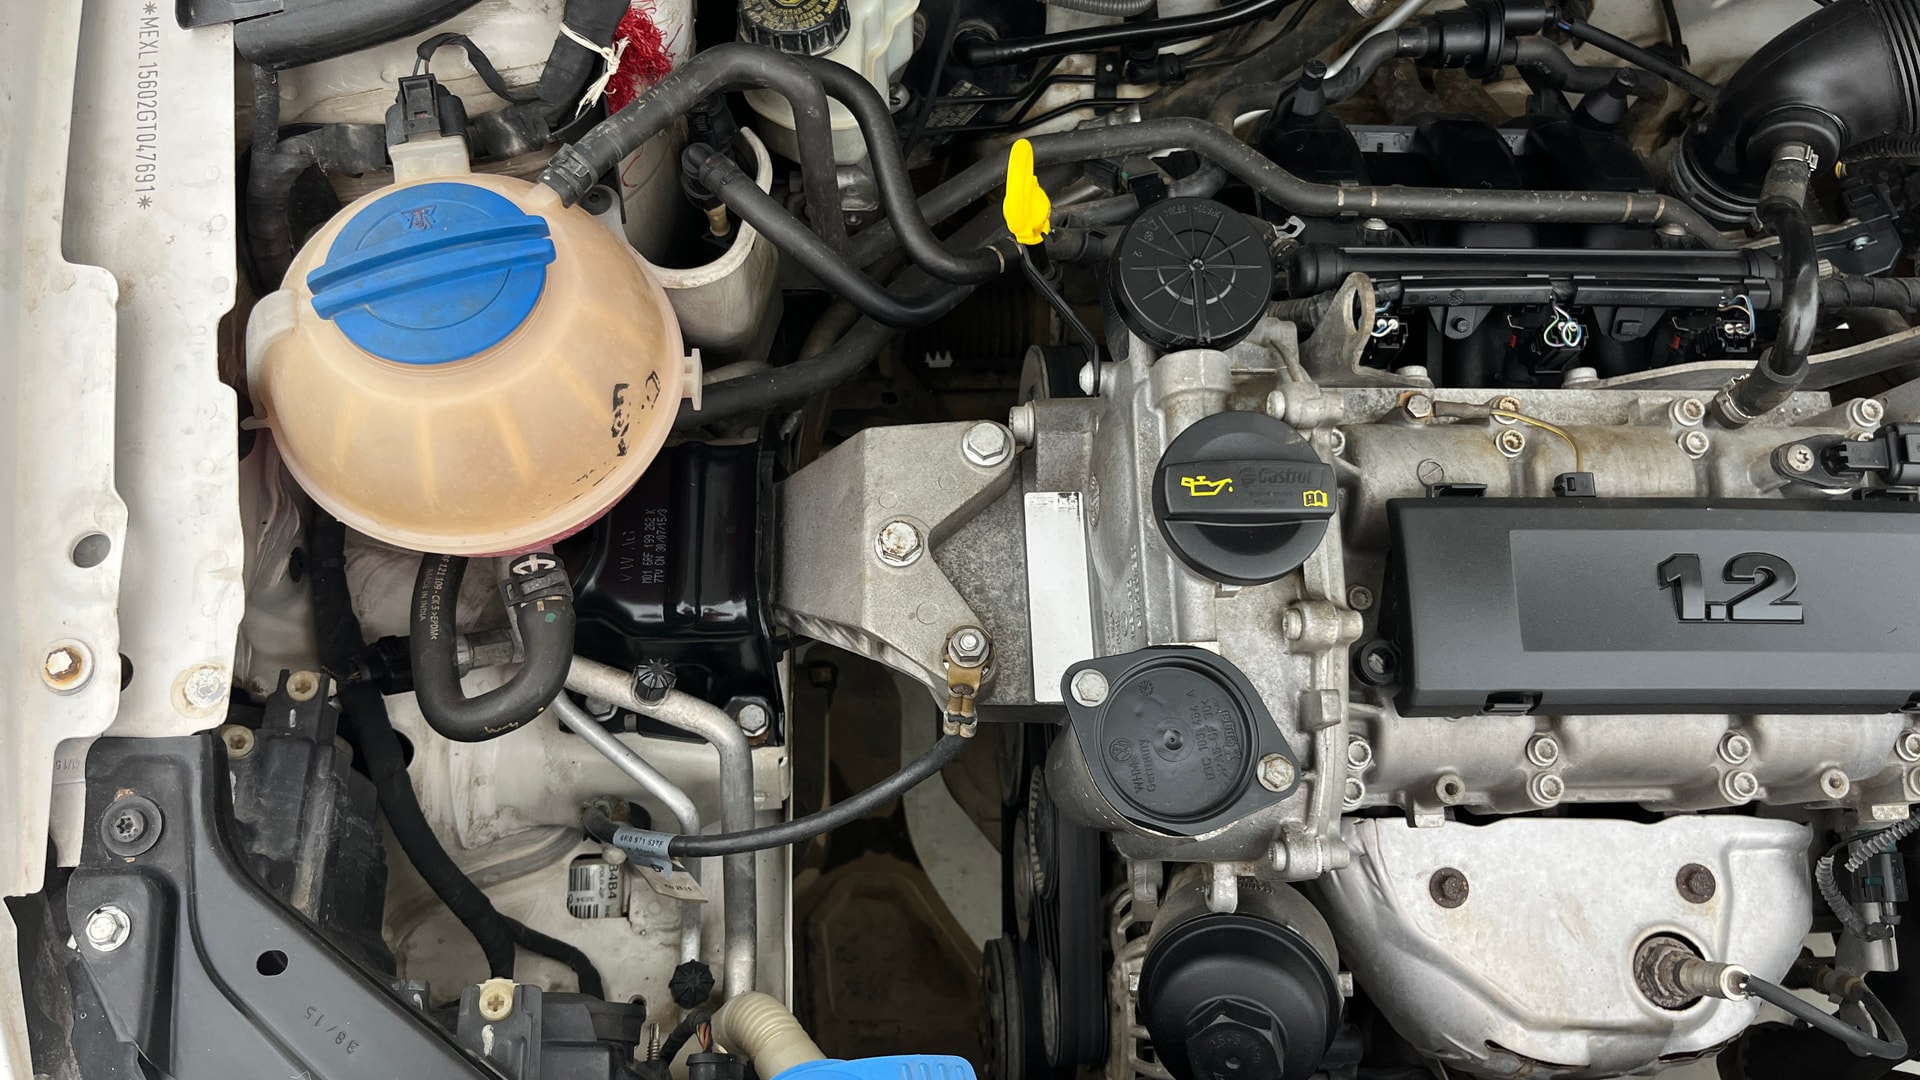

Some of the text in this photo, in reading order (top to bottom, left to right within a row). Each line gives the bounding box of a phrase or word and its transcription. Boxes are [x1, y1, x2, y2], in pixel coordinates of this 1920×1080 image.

[1258, 468, 1313, 484] Castrol
[644, 517, 655, 531] 262
[644, 534, 655, 548] 199
[437, 564, 447, 575] 121
[434, 577, 444, 590] 109
[1657, 552, 1804, 624] 1.2
[419, 568, 433, 622] MADE IN INDIA
[1138, 739, 1156, 792] Germany
[304, 1006, 360, 1055] 38/15
